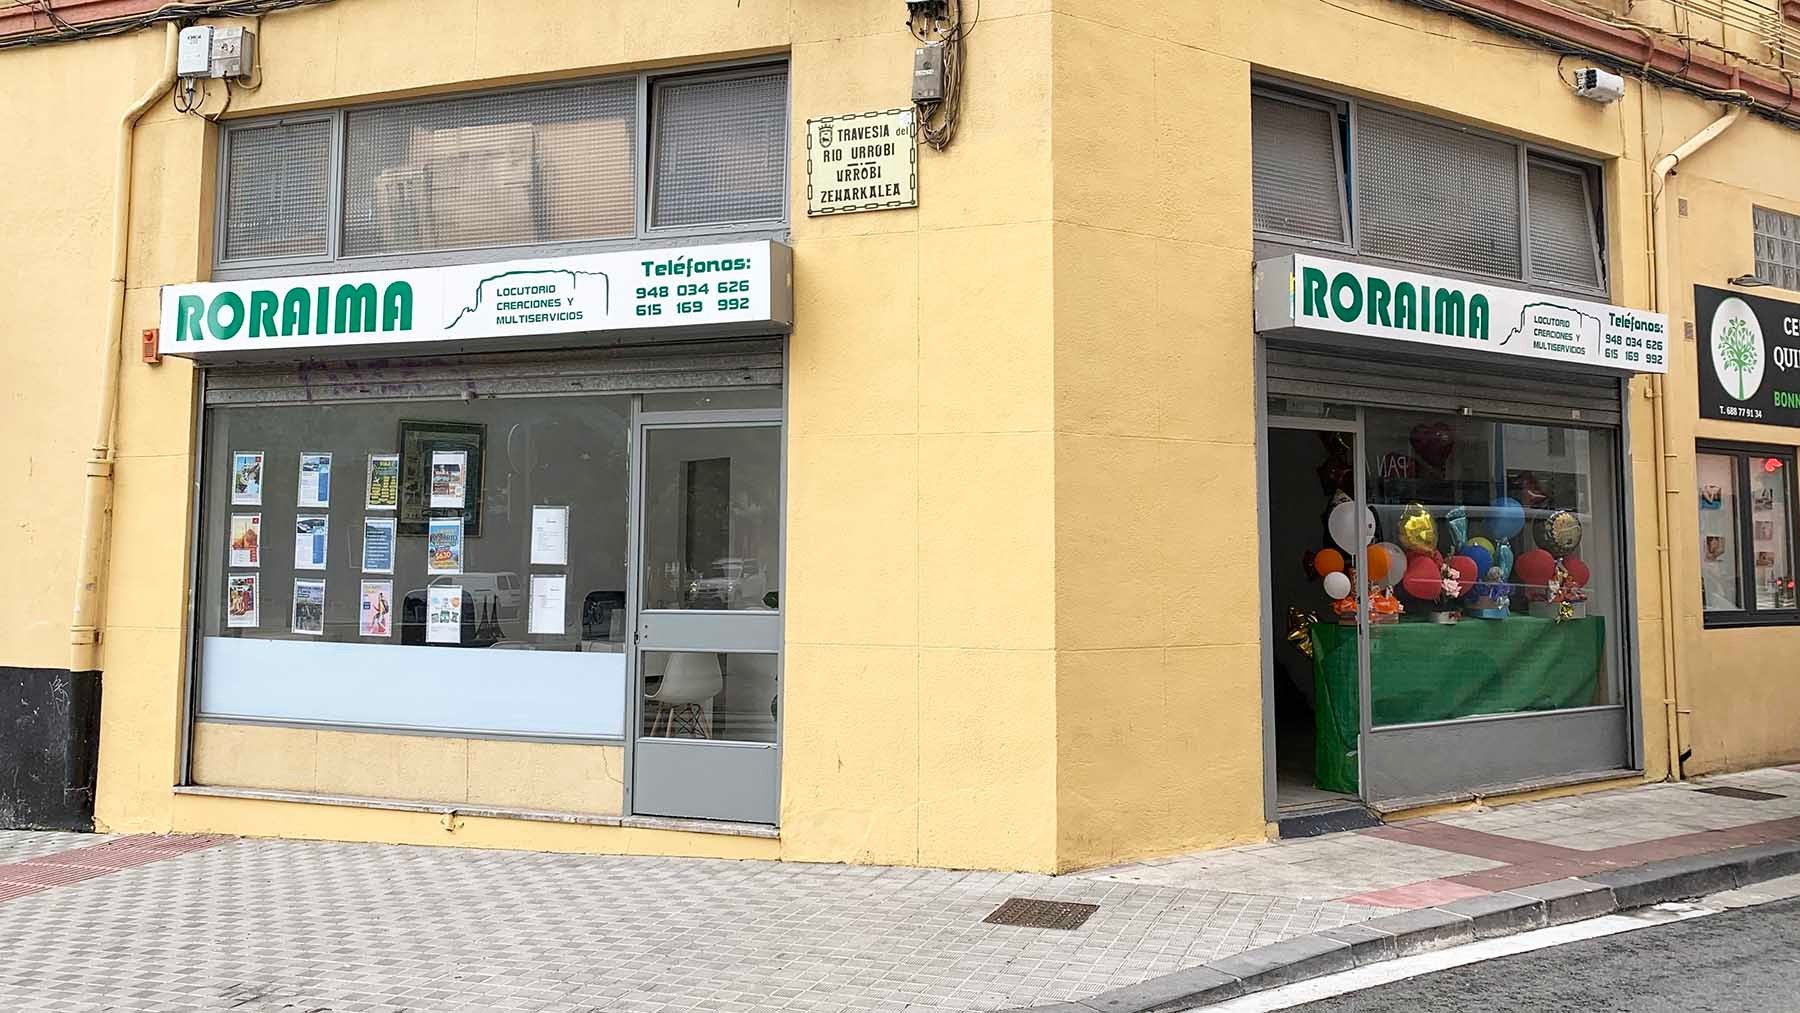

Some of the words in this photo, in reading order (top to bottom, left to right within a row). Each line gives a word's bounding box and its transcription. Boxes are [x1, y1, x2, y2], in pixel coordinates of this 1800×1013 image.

[837, 124, 890, 142] TRAVESIA
[895, 126, 909, 137] del
[823, 148, 842, 163] RIO
[851, 142, 895, 160] URROBI
[836, 166, 881, 182] URROBI
[641, 255, 751, 277] Teléfonos:
[496, 285, 556, 297] LOCUTORIO
[636, 286, 669, 299] 948
[676, 283, 709, 296] 034
[717, 280, 750, 293] 626
[176, 281, 414, 341] RORAIMA
[496, 298, 561, 311] CREACIONES
[567, 297, 574, 306] Y
[636, 303, 662, 316] 615
[676, 301, 703, 314] 169
[717, 297, 750, 311] 992
[1302, 266, 1490, 341] RORAIMA
[496, 311, 584, 325] MULTISERVICIOS
[1534, 315, 1570, 328] LOCUTORIO
[1608, 312, 1664, 334] Teléfonos:
[1783, 317, 1800, 336] CE
[1533, 328, 1573, 341] CREACIONES
[1575, 334, 1581, 342] Y
[1605, 334, 1622, 345] 948
[1625, 336, 1643, 349] 034
[1645, 340, 1663, 351] 626
[1533, 340, 1586, 355] MULTISERVICIOS
[1604, 348, 1618, 359] 615
[1625, 351, 1639, 362] 169
[1645, 353, 1663, 365] 992
[1774, 346, 1800, 371] QUI
